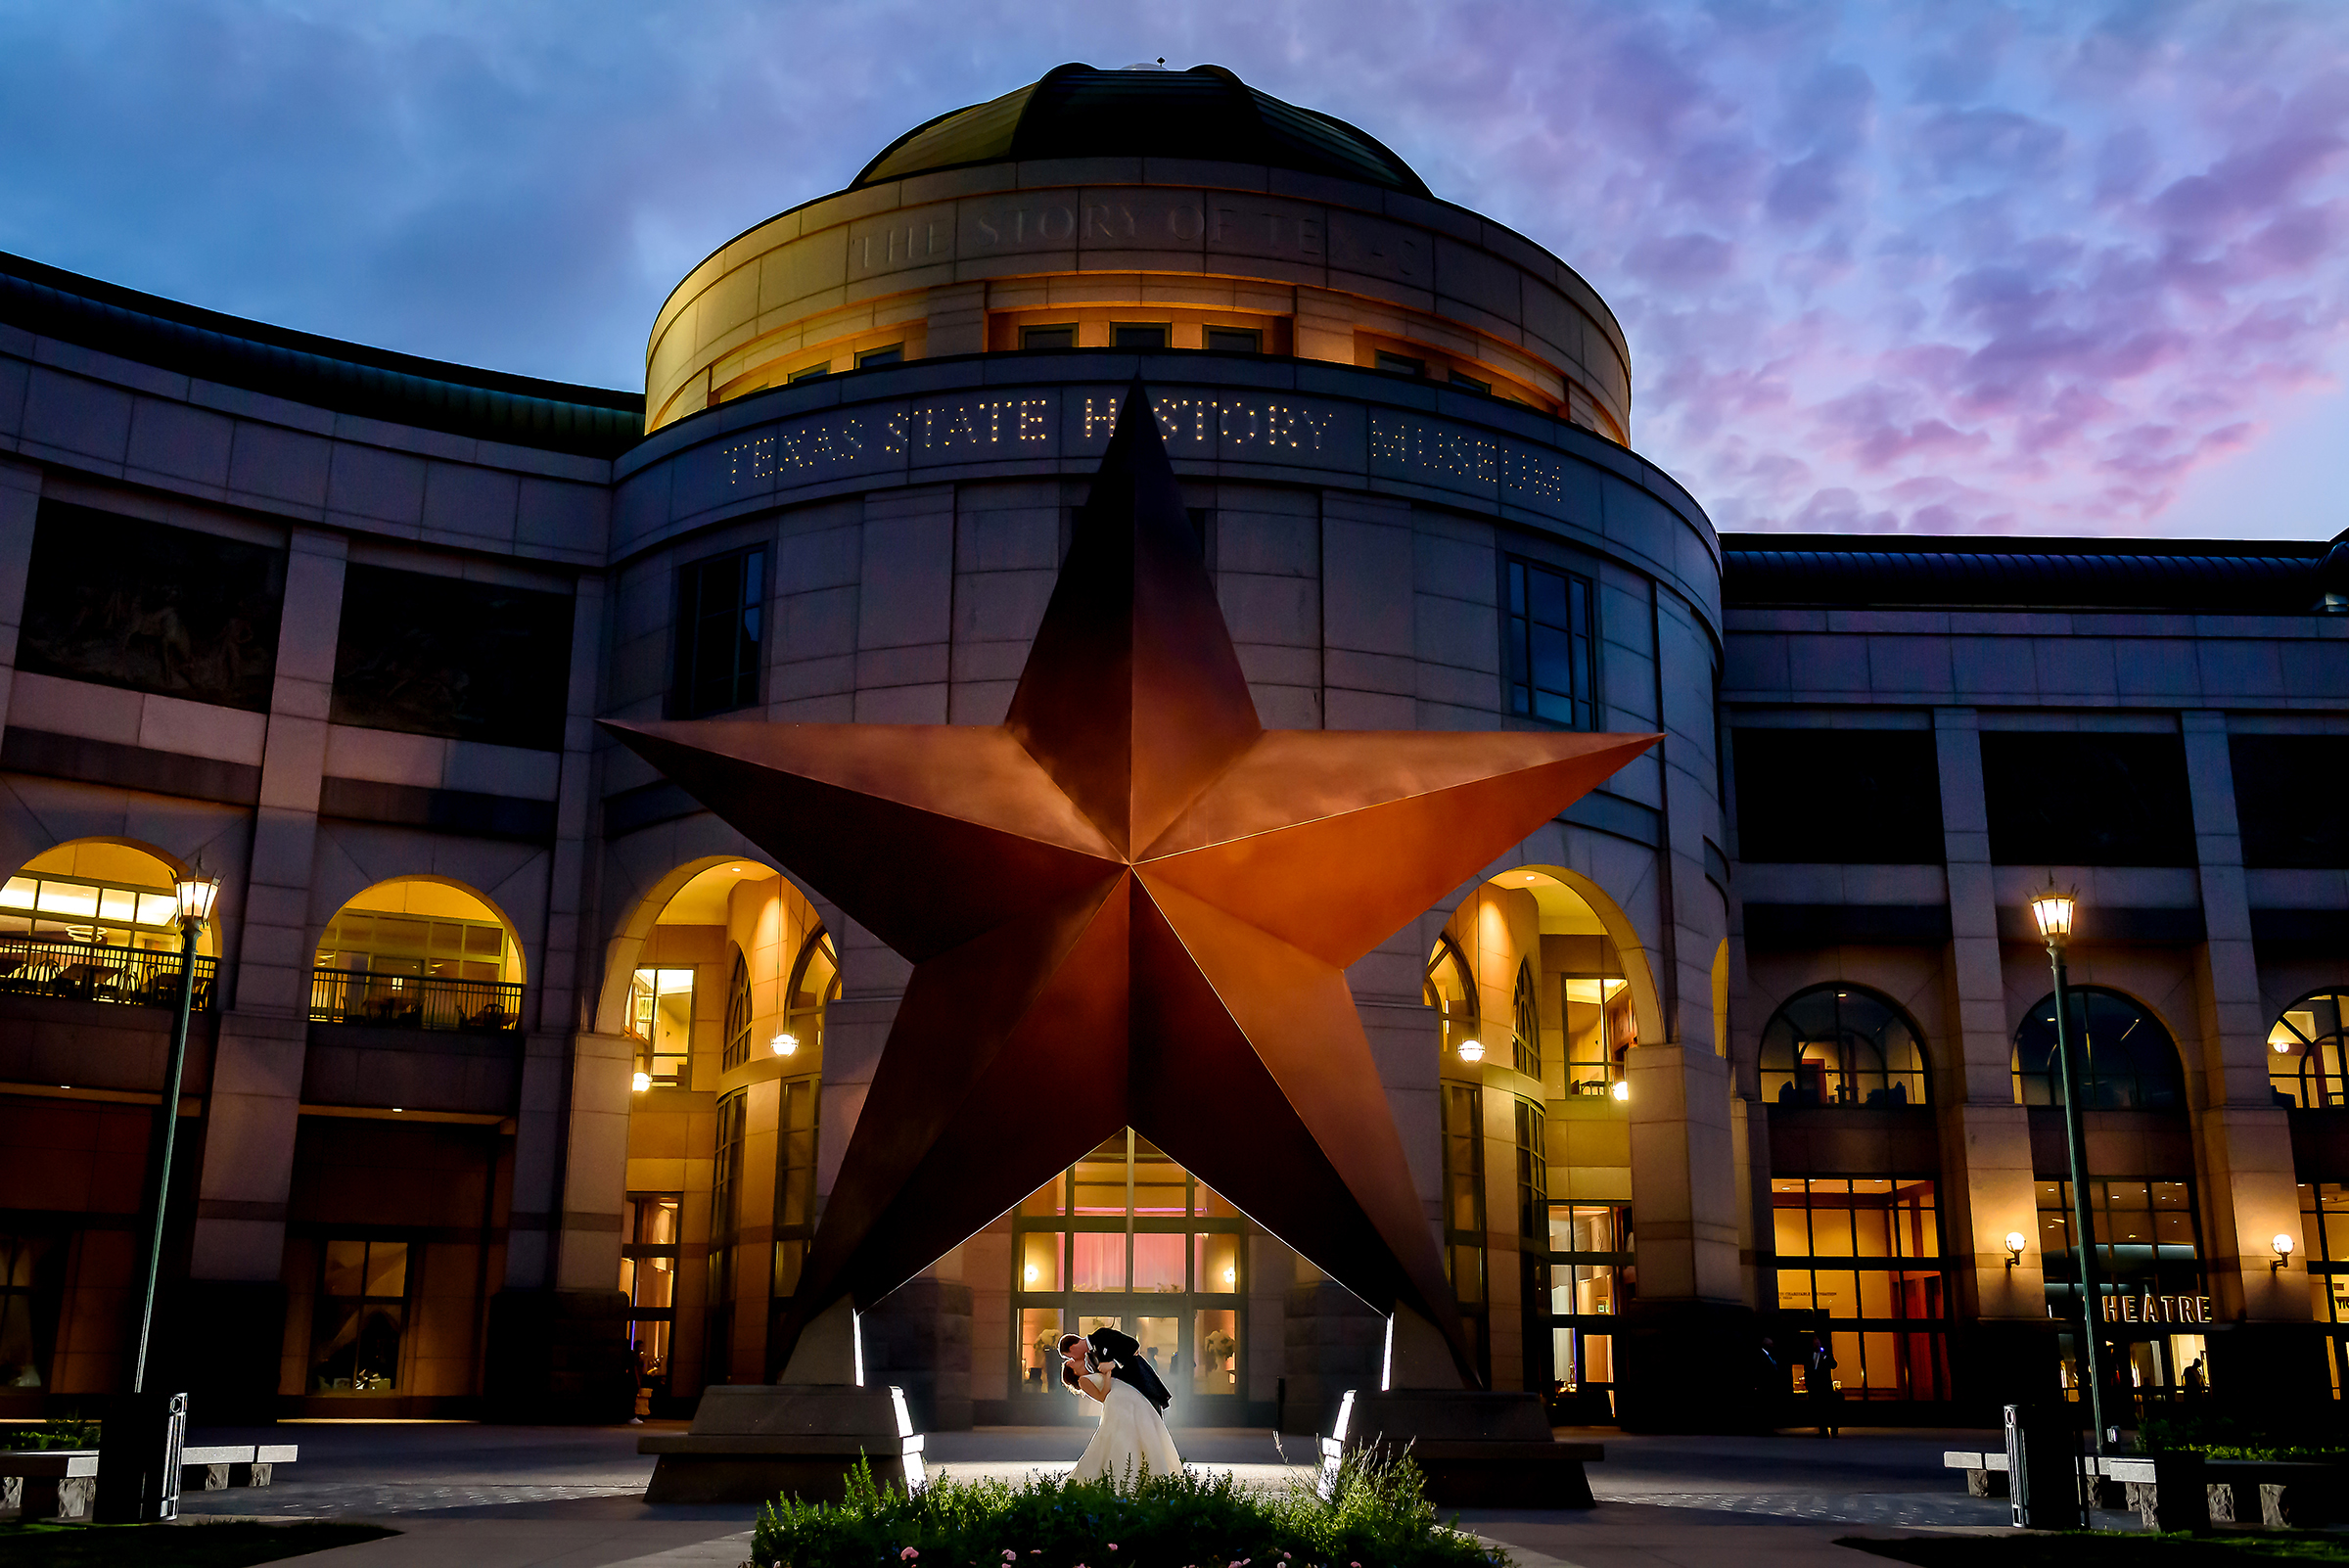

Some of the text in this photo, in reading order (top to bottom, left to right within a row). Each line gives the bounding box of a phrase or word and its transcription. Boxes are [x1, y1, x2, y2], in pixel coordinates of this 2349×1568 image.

[852, 204, 1416, 276] THE STORY OF TEXAS
[722, 397, 1562, 502] TEXAS STATE HSTORY MUSEUM
[2083, 1295, 2212, 1323] HEATRE
